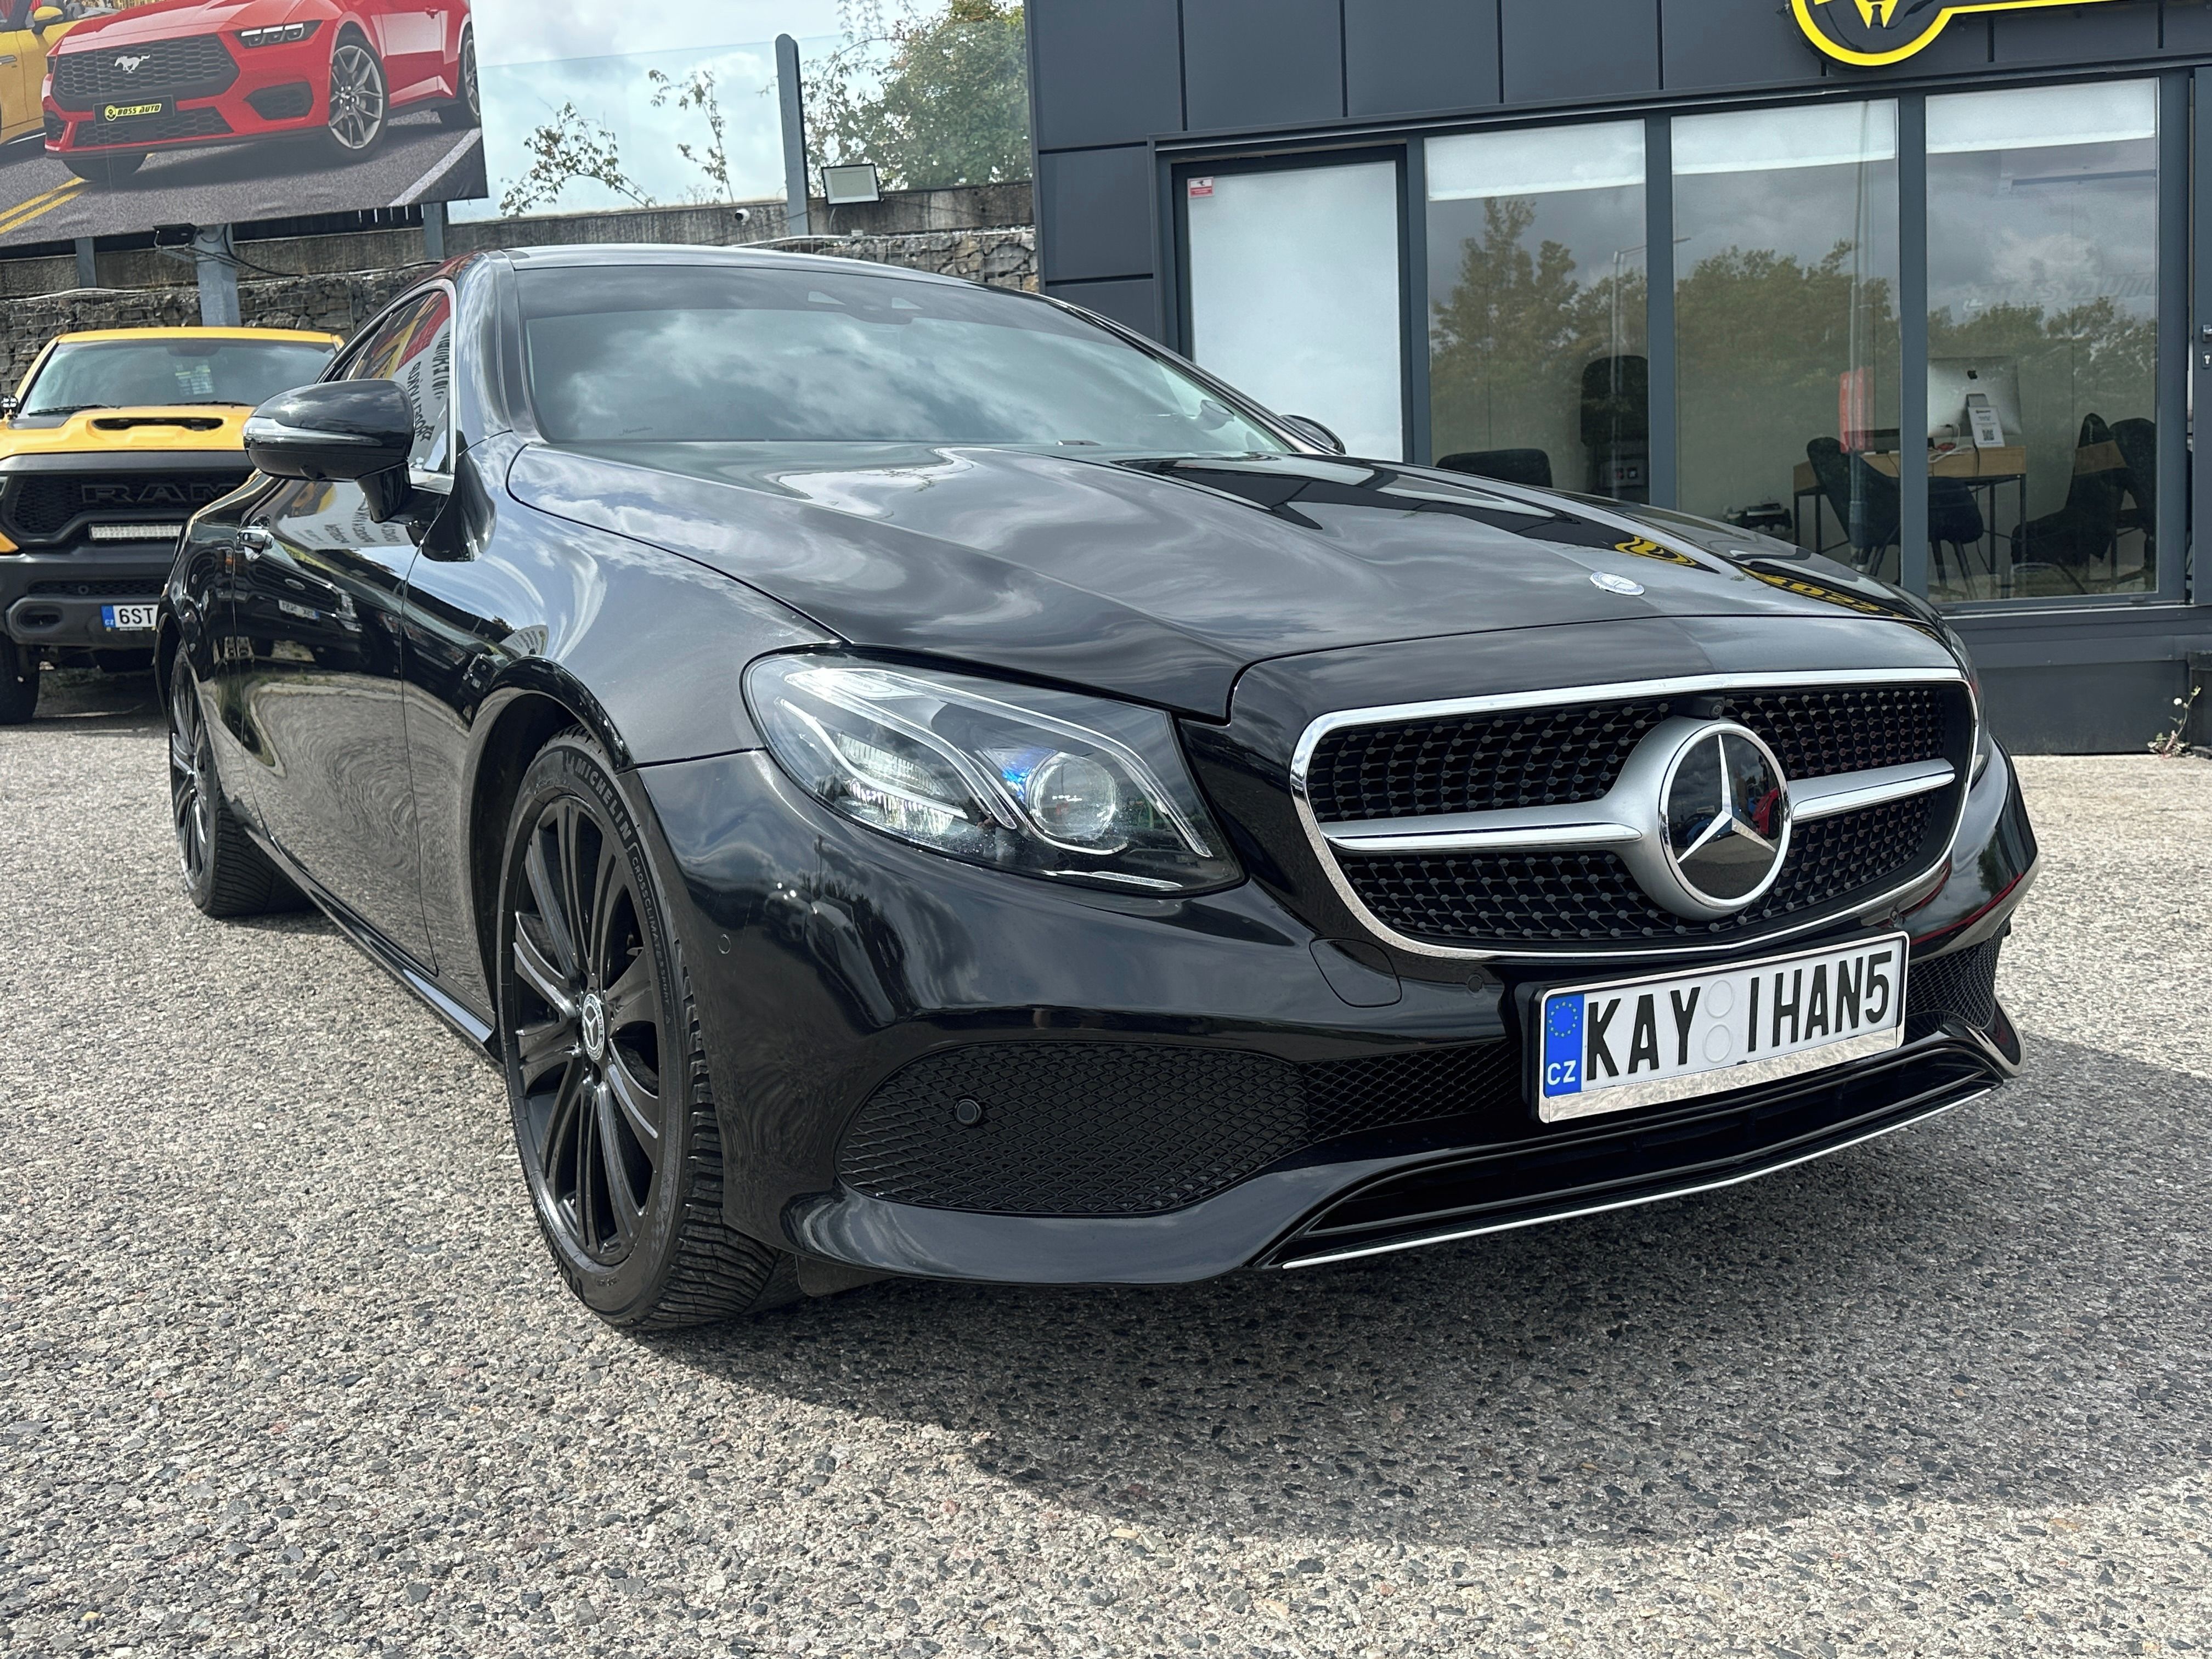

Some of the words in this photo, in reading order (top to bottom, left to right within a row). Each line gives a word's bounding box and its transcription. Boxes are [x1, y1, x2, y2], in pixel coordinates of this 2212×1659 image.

[139, 105, 160, 113] AUTO
[81, 483, 240, 503] RAM
[119, 608, 153, 624] 6ST
[575, 758, 631, 840] MICHELIN
[1587, 986, 1701, 1081] KAY
[1547, 1060, 1576, 1085] CZ
